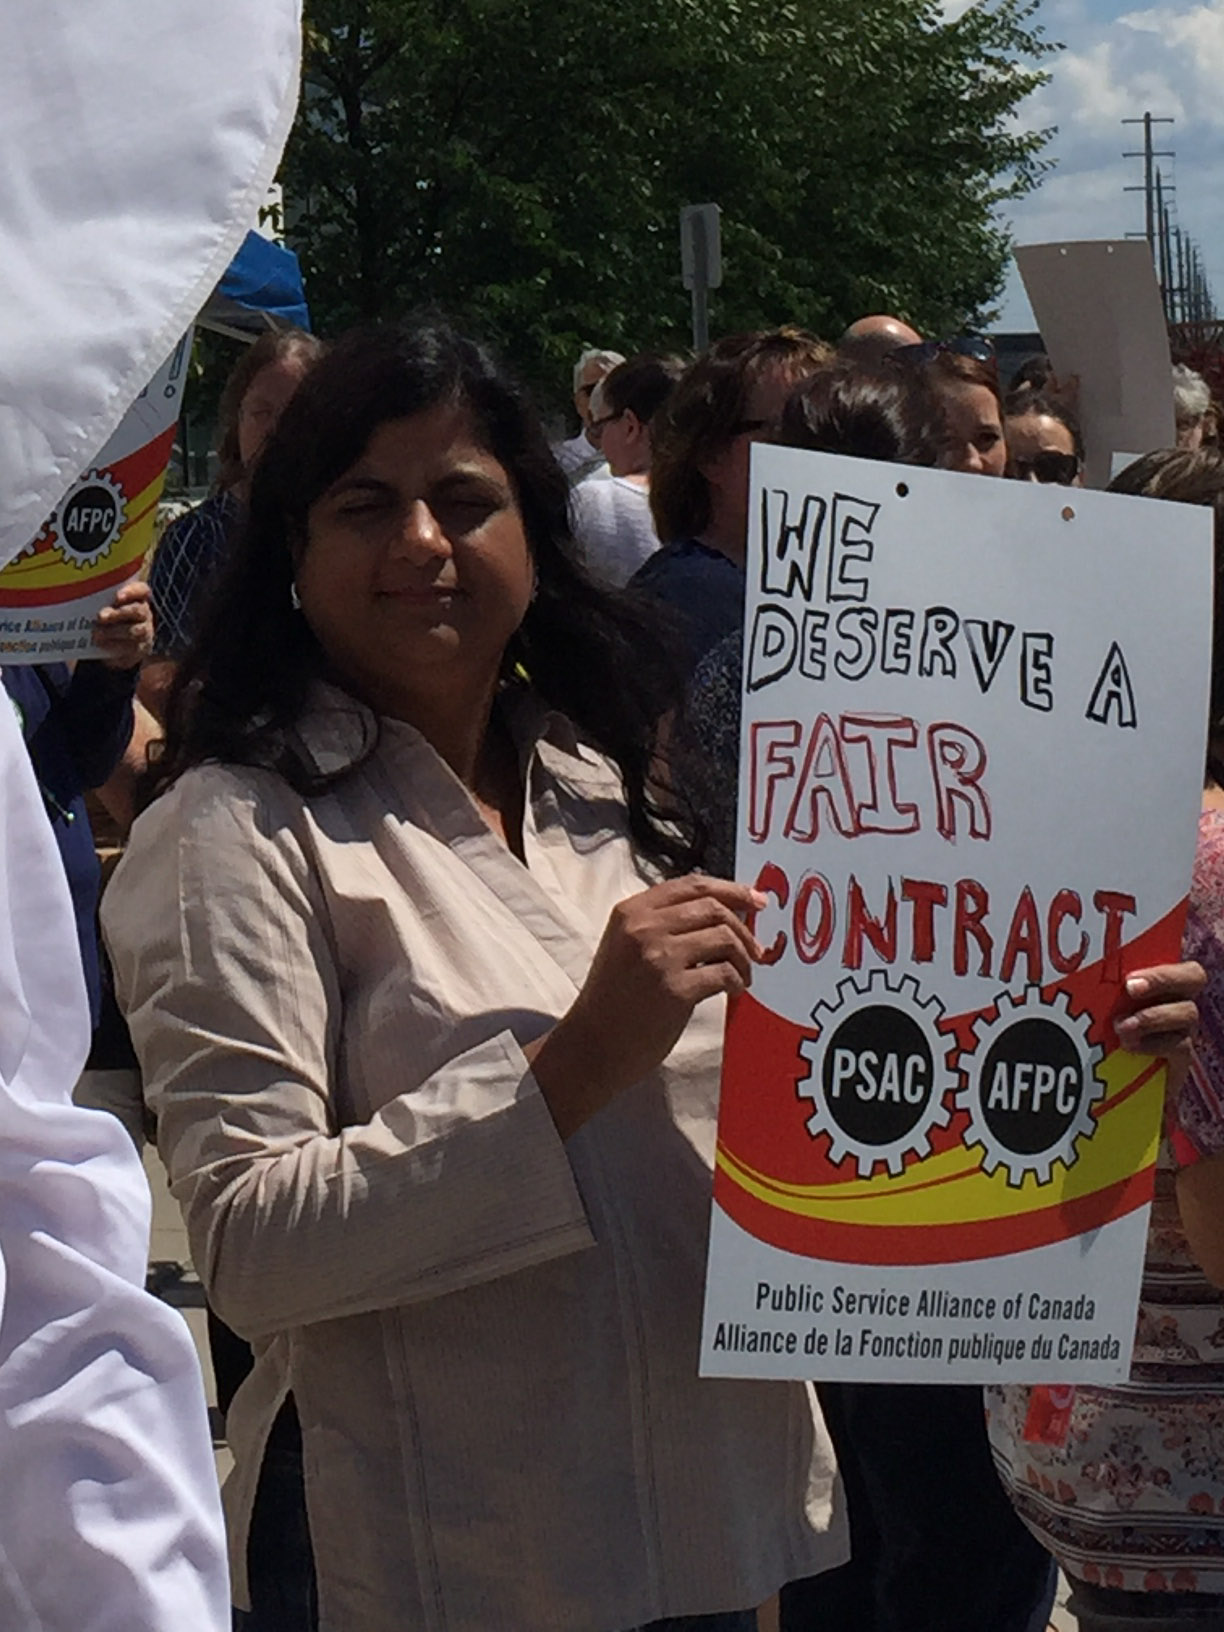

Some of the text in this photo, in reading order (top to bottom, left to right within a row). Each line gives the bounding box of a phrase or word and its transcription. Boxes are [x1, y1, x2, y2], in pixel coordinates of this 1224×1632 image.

[66, 507, 115, 533] AFPC
[761, 487, 881, 602] WE
[746, 604, 1138, 729] DESERVE A
[747, 711, 992, 843] FAIR
[747, 861, 1138, 984] CONTRACT
[831, 1048, 1078, 1114] PSAC AFPC
[712, 1322, 1121, 1366] Alliance de la Fonction publique du Canada
[756, 1282, 1096, 1321] Public Service Alliance of Canada
